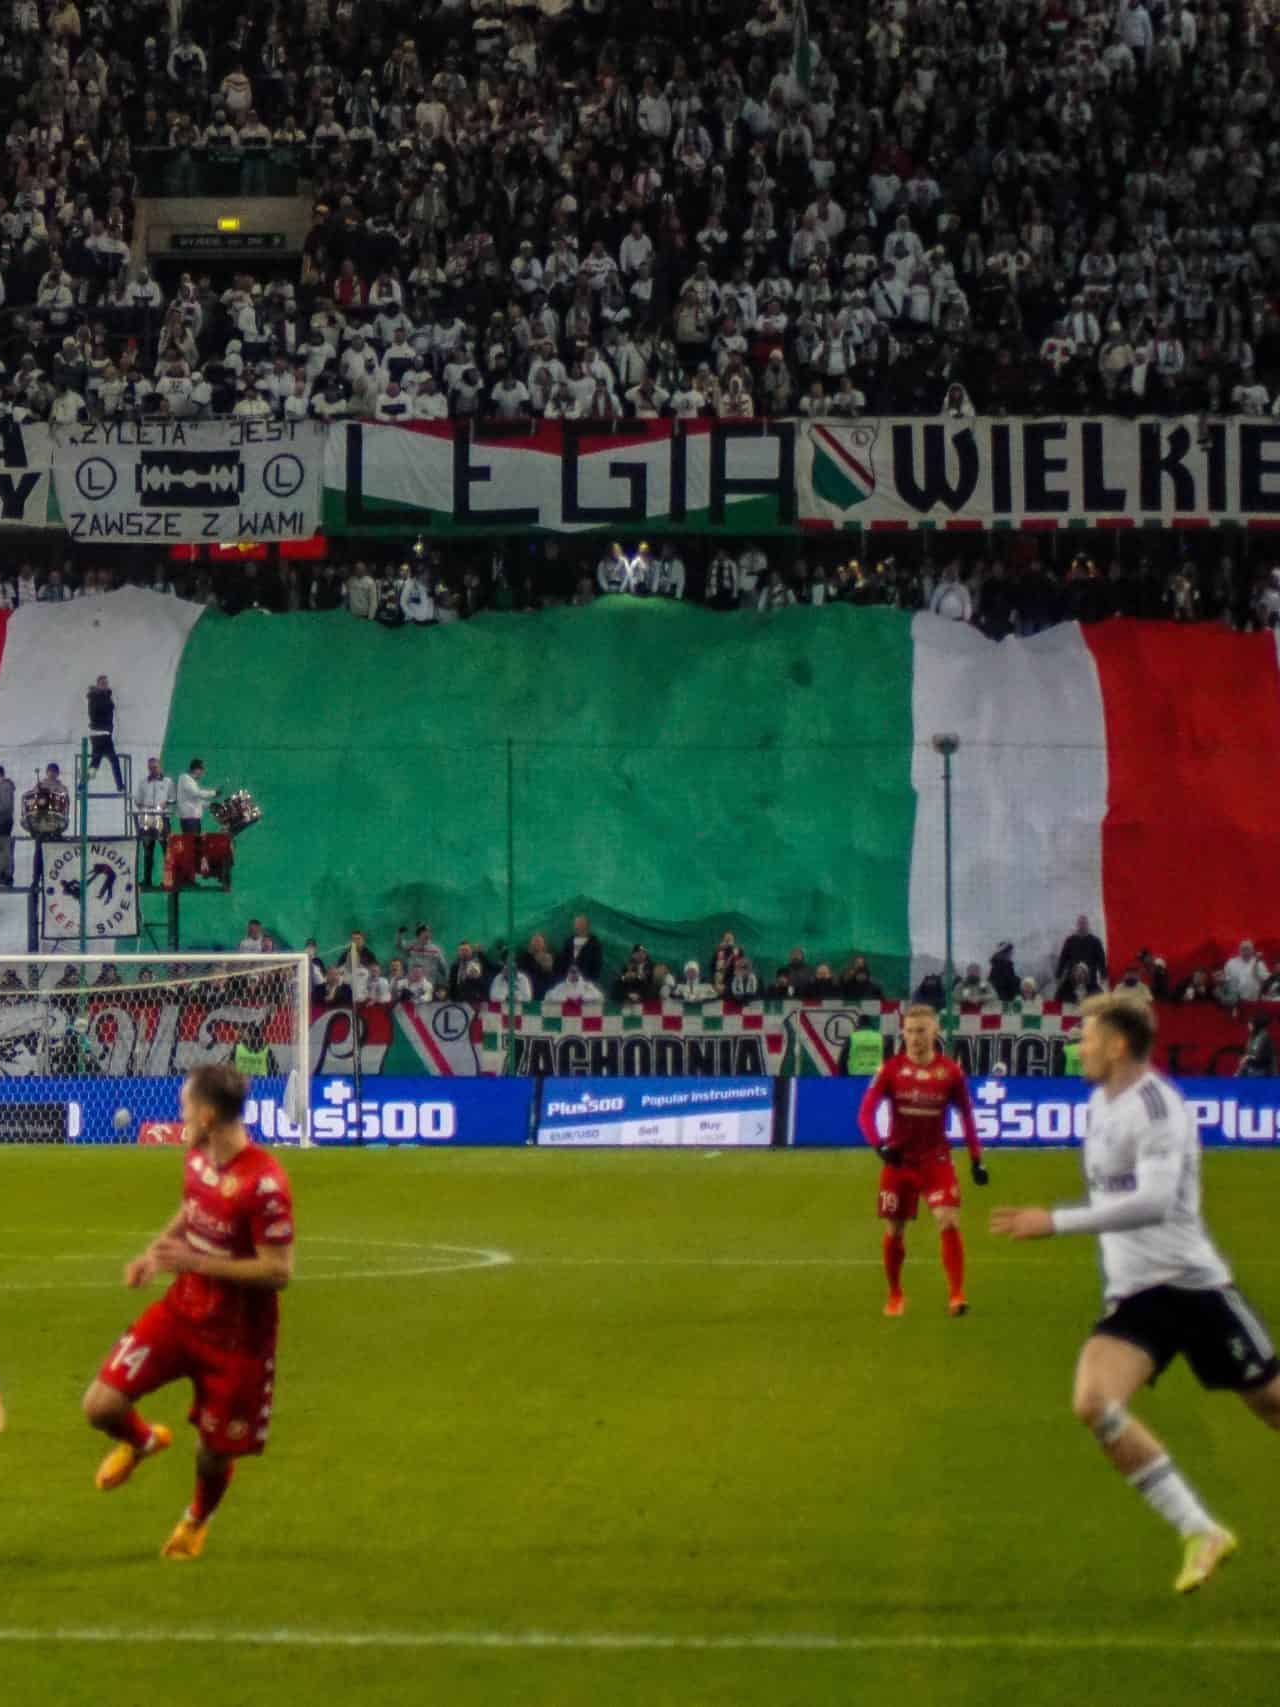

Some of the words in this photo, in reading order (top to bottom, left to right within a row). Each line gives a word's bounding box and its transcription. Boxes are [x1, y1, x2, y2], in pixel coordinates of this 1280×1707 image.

[229, 420, 298, 446] JEST
[345, 419, 795, 525] LEGIA
[71, 513, 182, 537] ZAWSZE
[201, 513, 220, 536] Z
[238, 511, 305, 536] WAMI
[90, 843, 131, 876] NIGHT
[96, 899, 130, 934] SIDE
[547, 1096, 624, 1117] Plus500
[109, 1335, 151, 1381] 14
